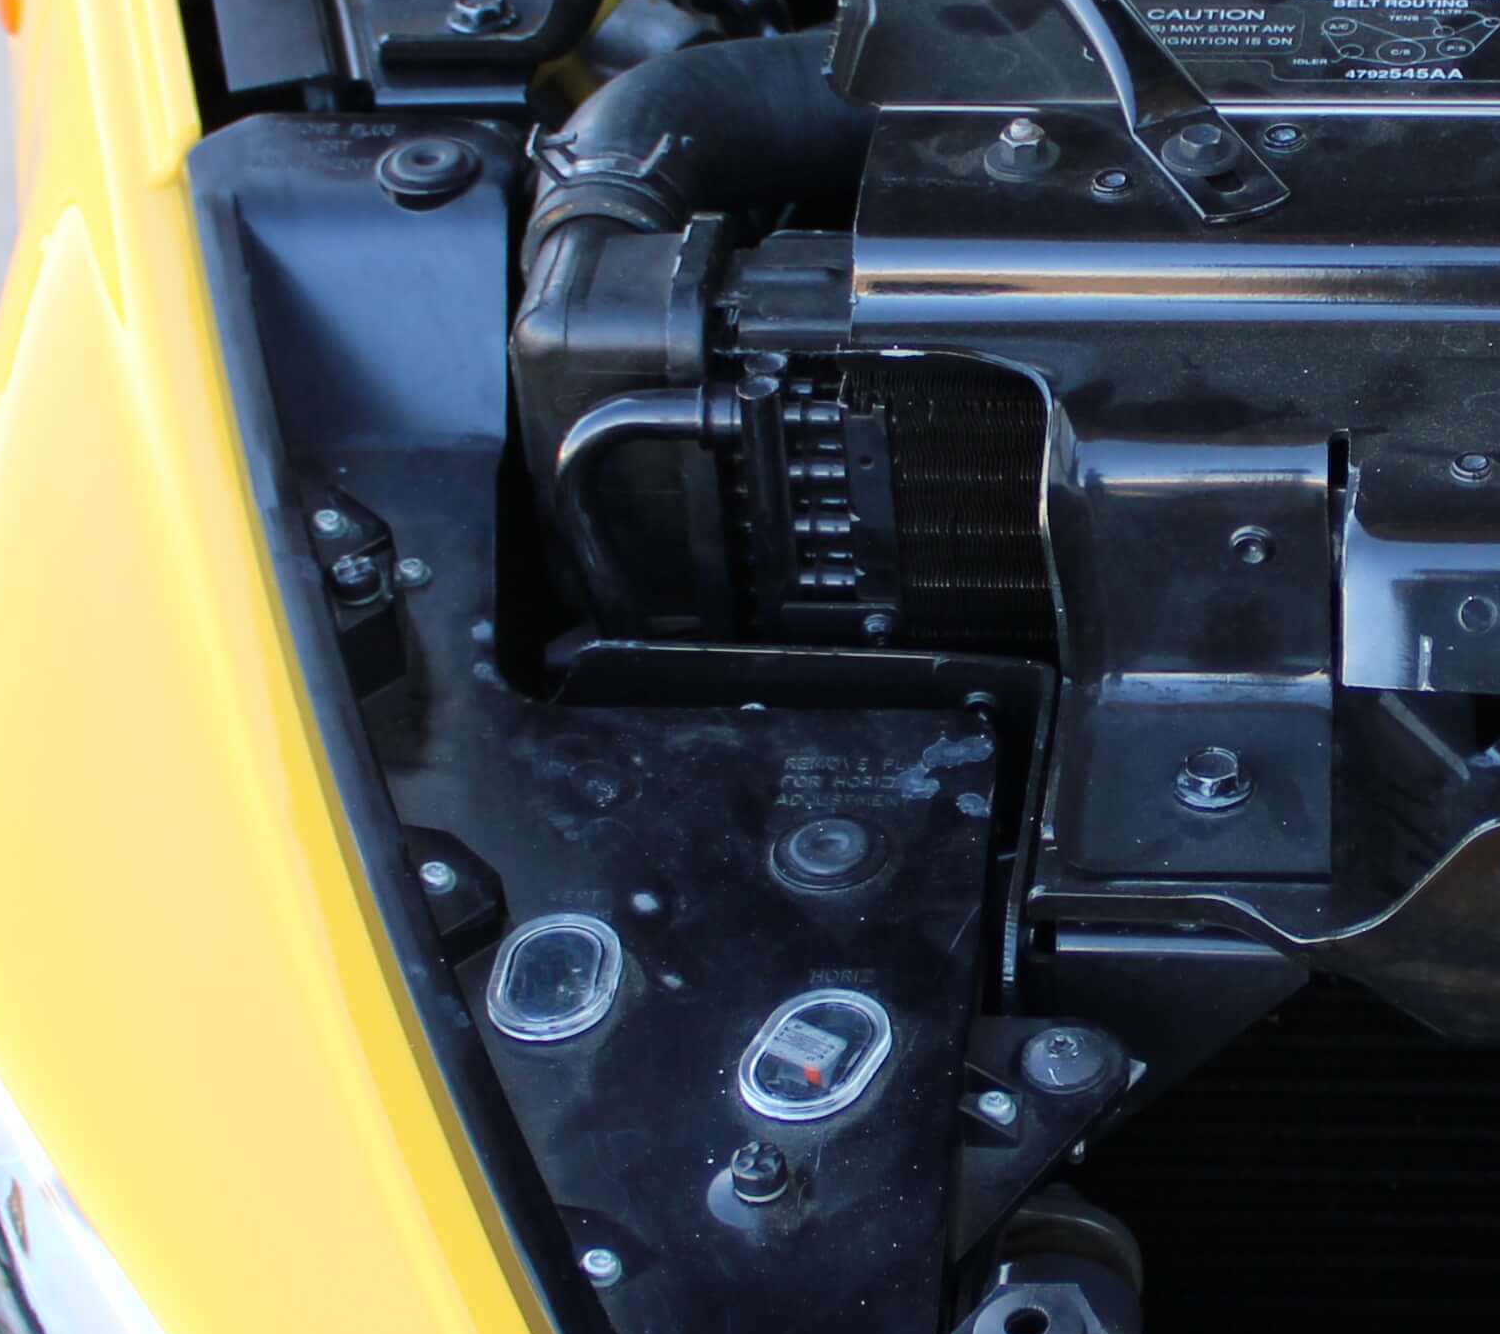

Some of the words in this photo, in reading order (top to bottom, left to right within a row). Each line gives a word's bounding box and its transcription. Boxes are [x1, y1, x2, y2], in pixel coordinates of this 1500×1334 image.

[1333, 0, 1383, 8] BELT
[1389, 0, 1469, 8] ROUTING
[1147, 8, 1266, 21] CAUTION
[1389, 15, 1420, 23] TENS
[1189, 24, 1205, 34] MAY
[1208, 24, 1258, 33] START
[1261, 24, 1297, 33] ANY
[1329, 23, 1350, 32] A/C
[1161, 37, 1244, 46] IGNITION
[1246, 37, 1263, 46] IS
[1266, 37, 1294, 46] ON
[1292, 58, 1329, 66] IDLER
[1345, 68, 1464, 79] 4792545AA
[784, 756, 869, 772] REMOVE
[780, 774, 821, 788] FOR
[809, 967, 876, 982] HORIZ
